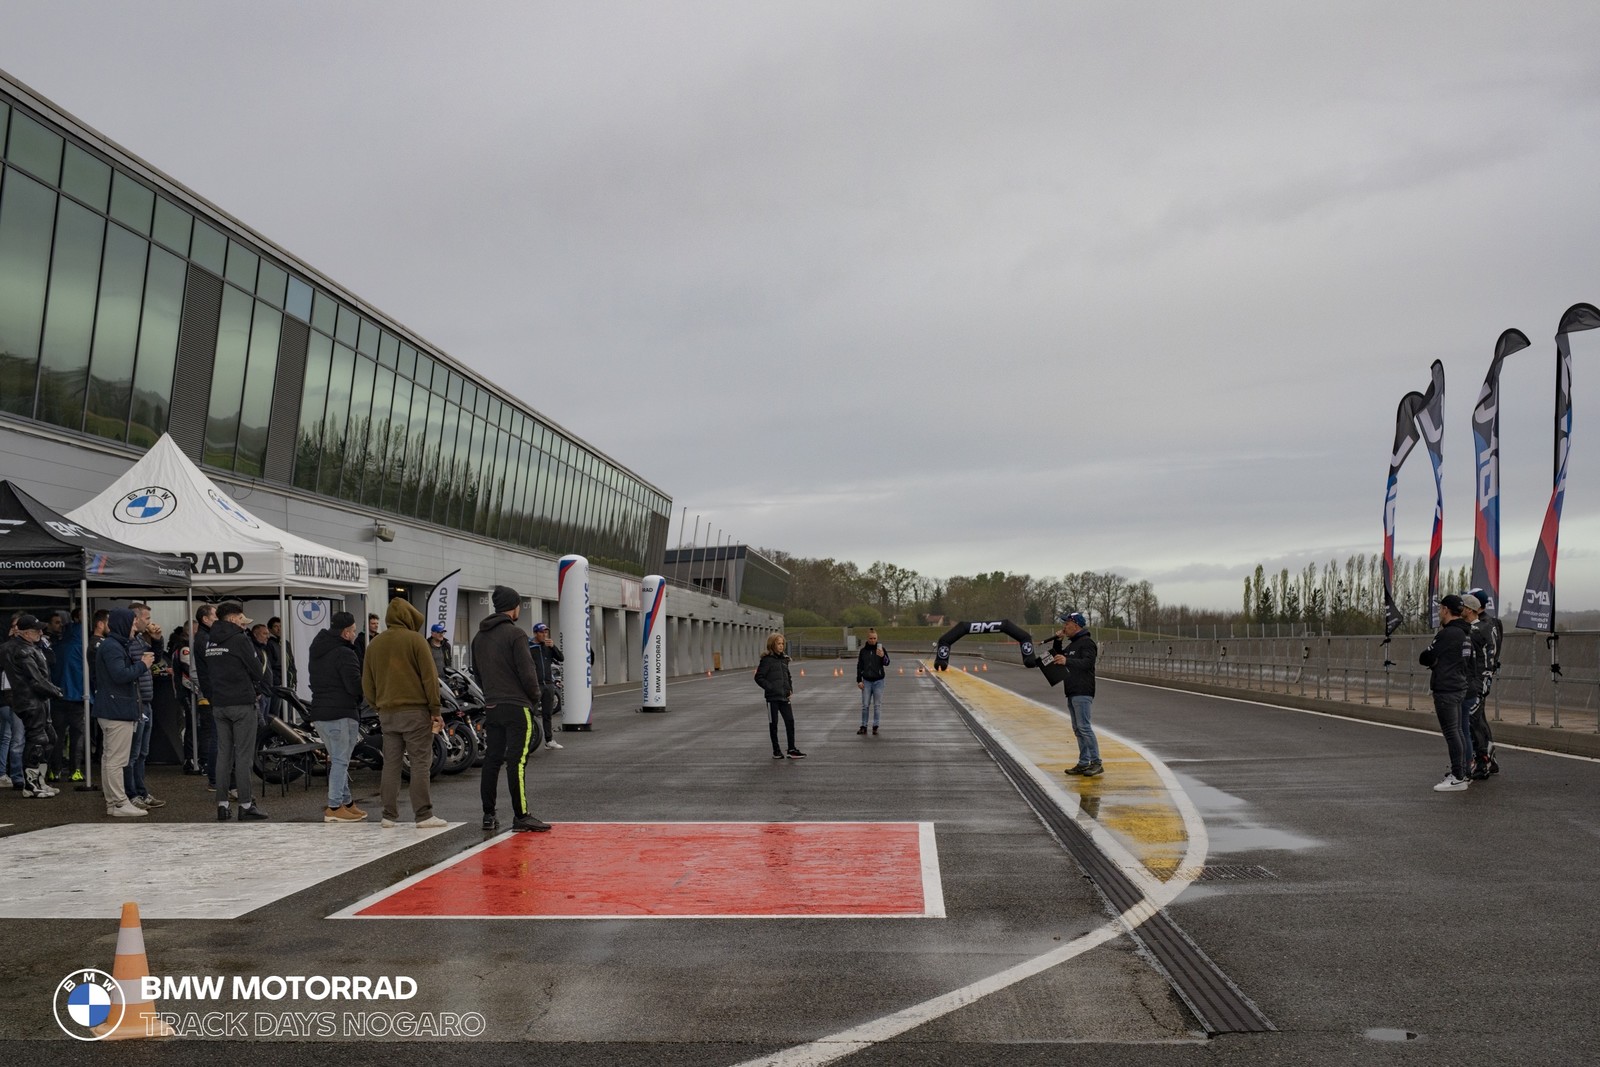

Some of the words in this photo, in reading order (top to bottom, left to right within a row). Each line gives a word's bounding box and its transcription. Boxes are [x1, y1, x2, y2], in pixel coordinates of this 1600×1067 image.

[127, 488, 171, 500] BMW
[294, 553, 315, 576] BMW
[317, 556, 361, 582] MOTORRAD
[969, 622, 1002, 634] BMC
